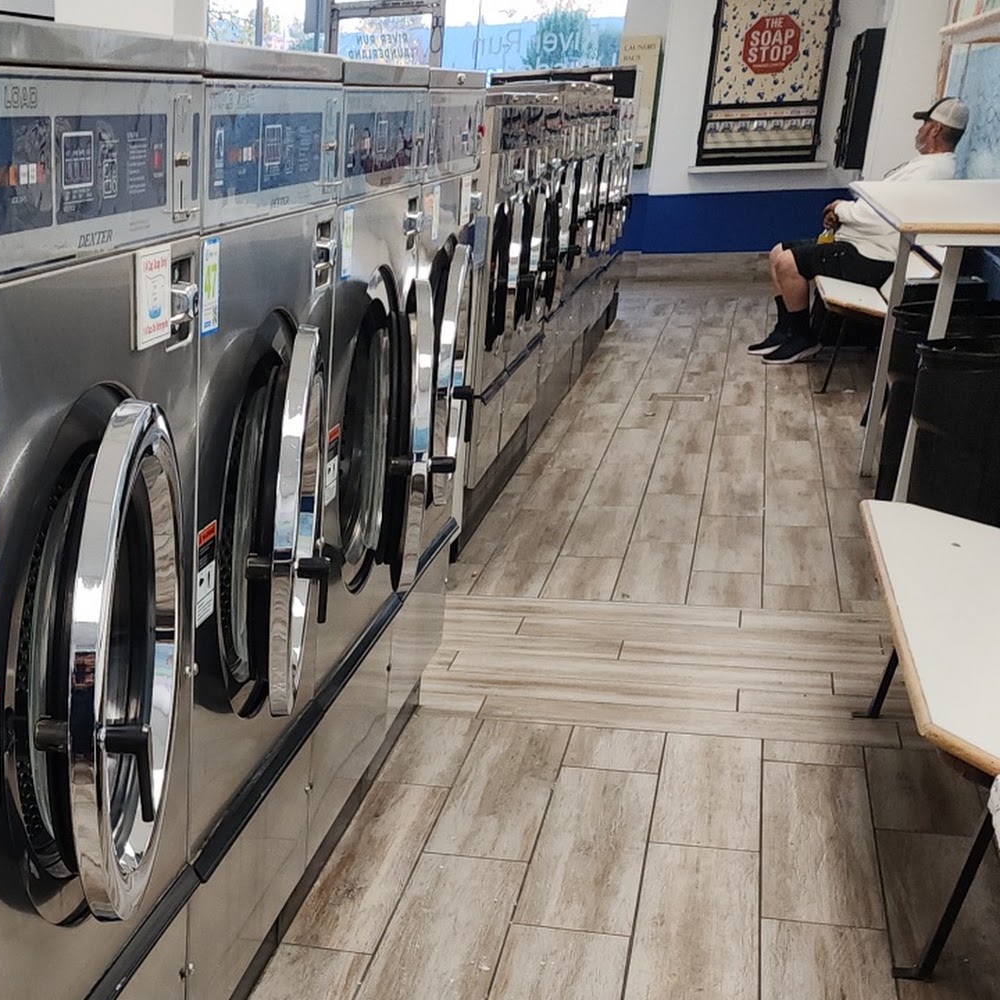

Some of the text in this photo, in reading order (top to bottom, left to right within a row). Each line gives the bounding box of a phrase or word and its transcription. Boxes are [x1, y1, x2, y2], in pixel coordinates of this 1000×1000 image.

[765, 17, 784, 28] THE
[750, 28, 794, 46] SOAP
[748, 44, 794, 63] STOP
[4, 86, 38, 109] LOAD
[78, 230, 113, 248] DEXTER
